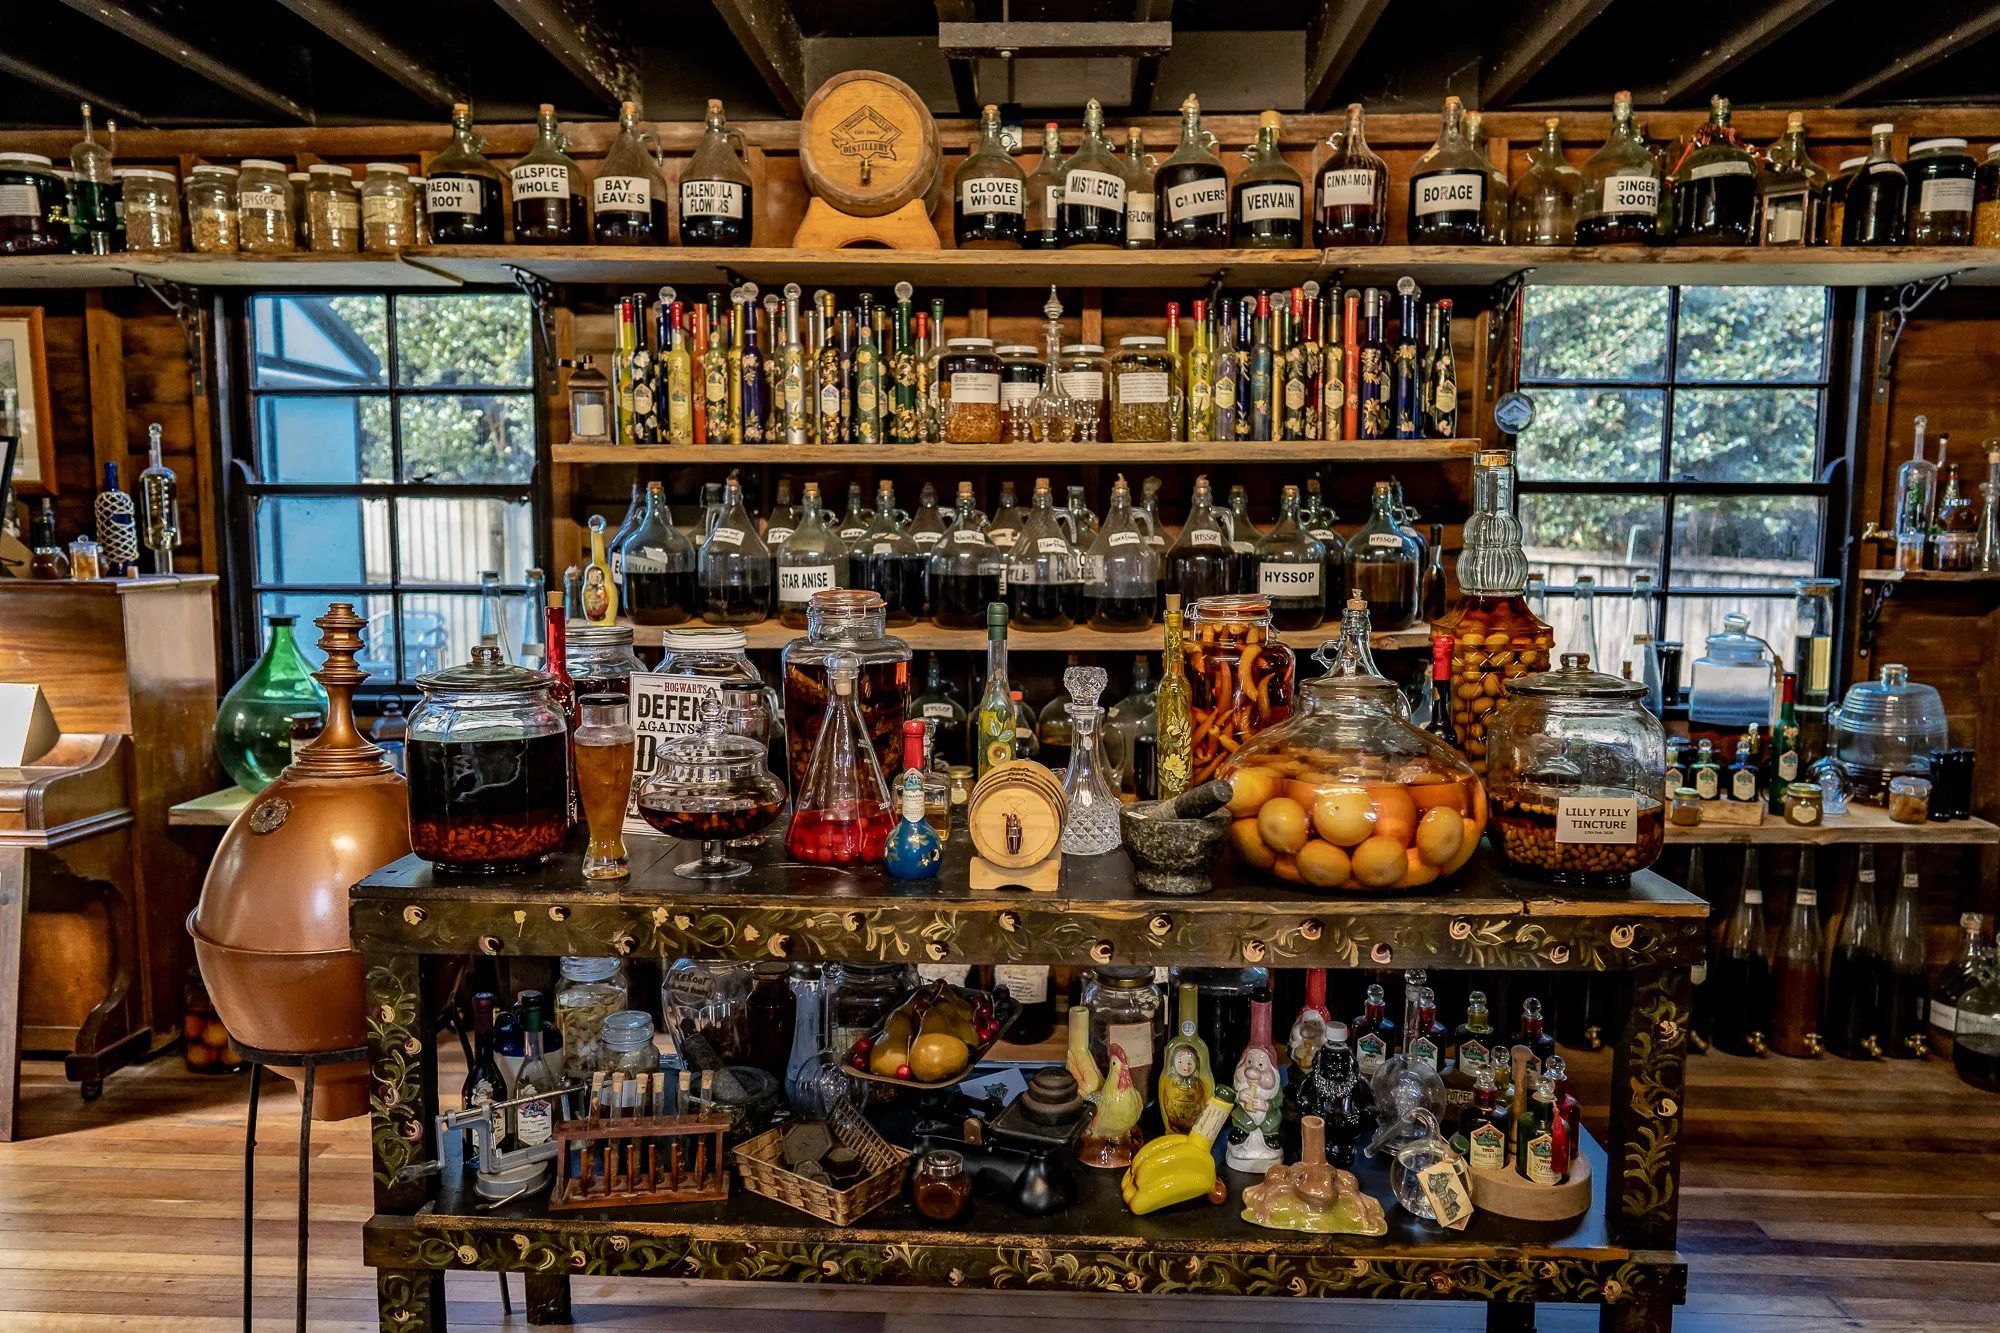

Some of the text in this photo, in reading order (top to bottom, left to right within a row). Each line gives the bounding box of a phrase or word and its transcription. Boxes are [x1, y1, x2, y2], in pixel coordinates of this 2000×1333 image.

[843, 142, 888, 154] DISTILLERY
[513, 167, 567, 180] ALLSPICE
[605, 180, 631, 191] BAY
[1070, 175, 1119, 199] MISTLETOE
[1326, 173, 1373, 188] CINNAMON
[1616, 180, 1656, 193] GINGER
[427, 181, 474, 194] PAEONIA
[517, 181, 559, 194] WHOLE
[685, 183, 733, 200] CALENDULA
[970, 182, 1019, 194] CLOVES
[1423, 185, 1473, 202] BORAGE
[432, 196, 463, 208] ROOT
[597, 192, 645, 204] LEAVES
[971, 195, 1016, 206] WHOLE
[1246, 192, 1295, 211] VERVAIN
[1615, 195, 1657, 208] ROOTS
[781, 572, 828, 588] STAR ANISE
[1264, 570, 1315, 583] HYSSOP
[664, 682, 708, 695] HOGWARTS
[638, 693, 704, 722] DEFEN
[636, 720, 695, 735] AGAINS
[1565, 808, 1631, 817] LILLY PILLY
[1571, 820, 1627, 829] TINCTURE
